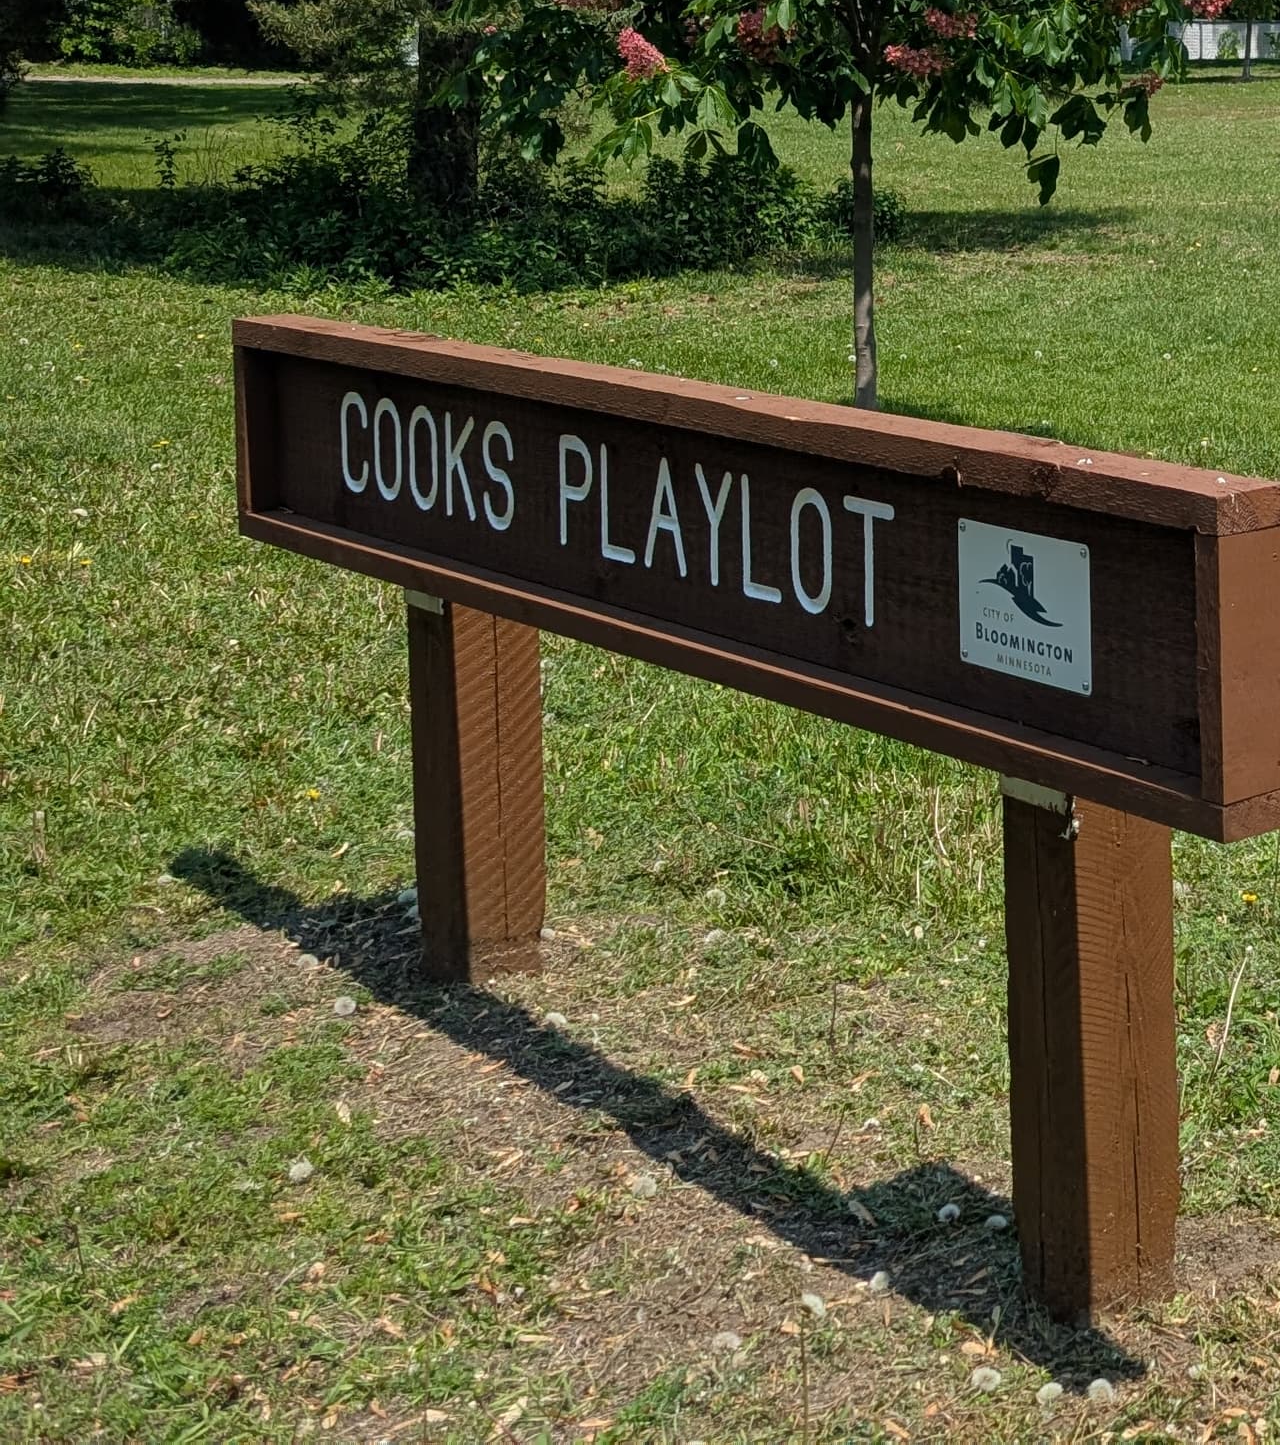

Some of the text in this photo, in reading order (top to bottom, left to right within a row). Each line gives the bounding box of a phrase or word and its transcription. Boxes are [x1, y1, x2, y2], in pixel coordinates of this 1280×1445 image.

[340, 391, 895, 627] COOKS PLAYLOT
[983, 607, 1014, 623] CITY OF
[975, 621, 1073, 664] BLOOMINGTON
[997, 653, 1052, 676] MINNESOTA
